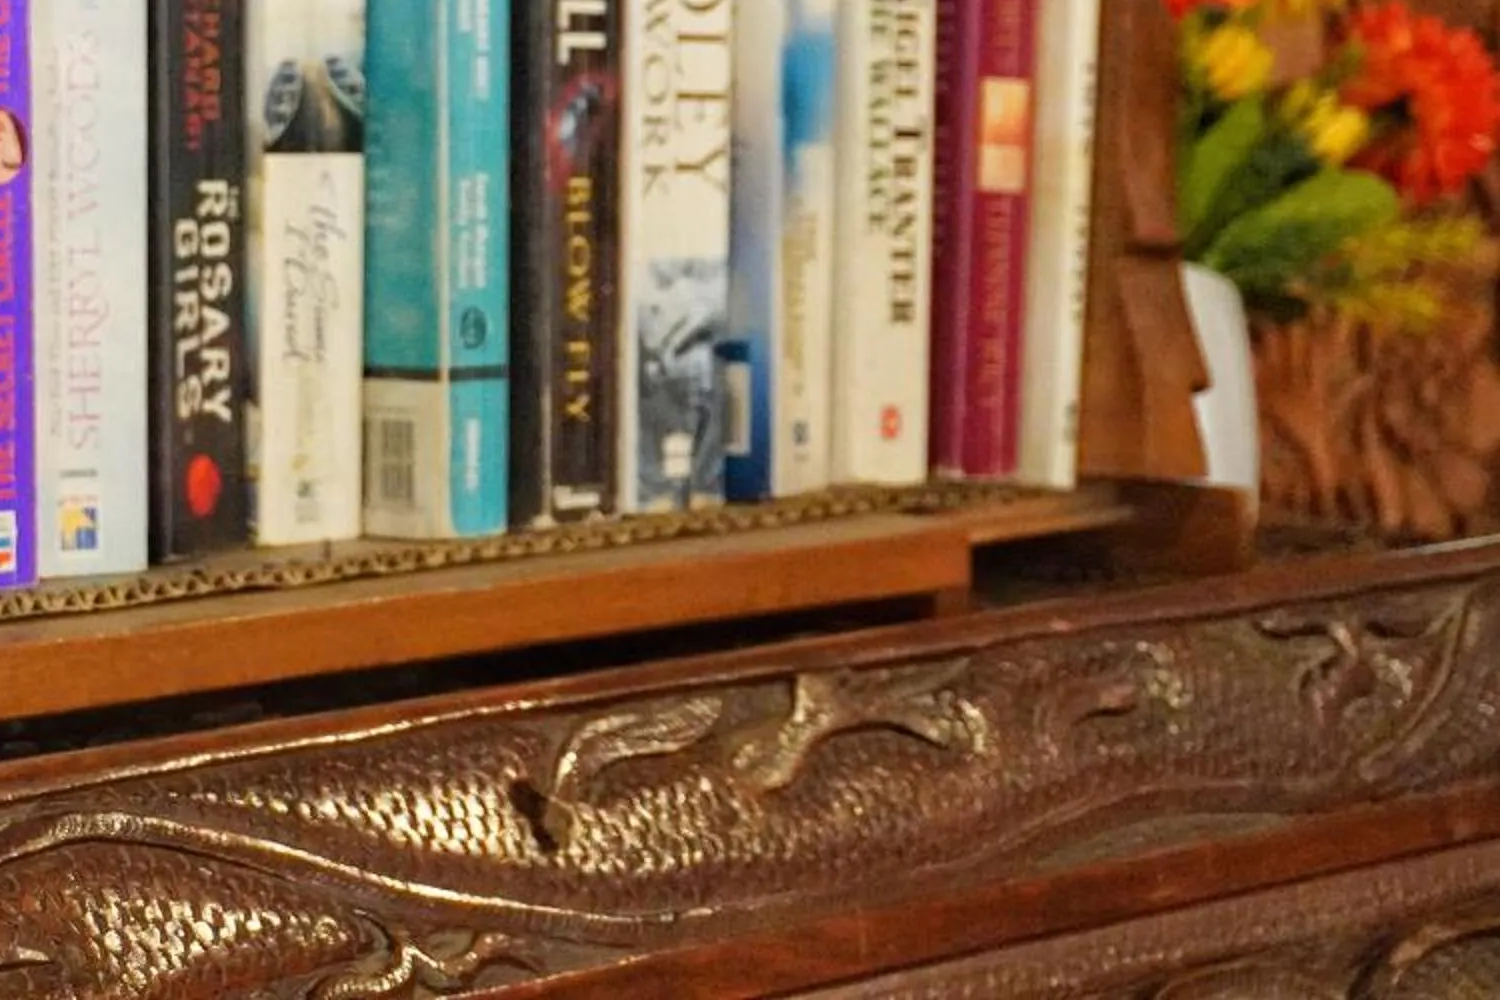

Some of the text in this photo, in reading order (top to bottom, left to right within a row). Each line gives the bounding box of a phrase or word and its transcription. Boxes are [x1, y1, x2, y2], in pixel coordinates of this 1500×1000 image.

[64, 227, 110, 452] SHERRYL
[172, 217, 202, 422] GIRLS
[195, 179, 234, 424] ROSARY
[564, 174, 595, 324] BLOW
